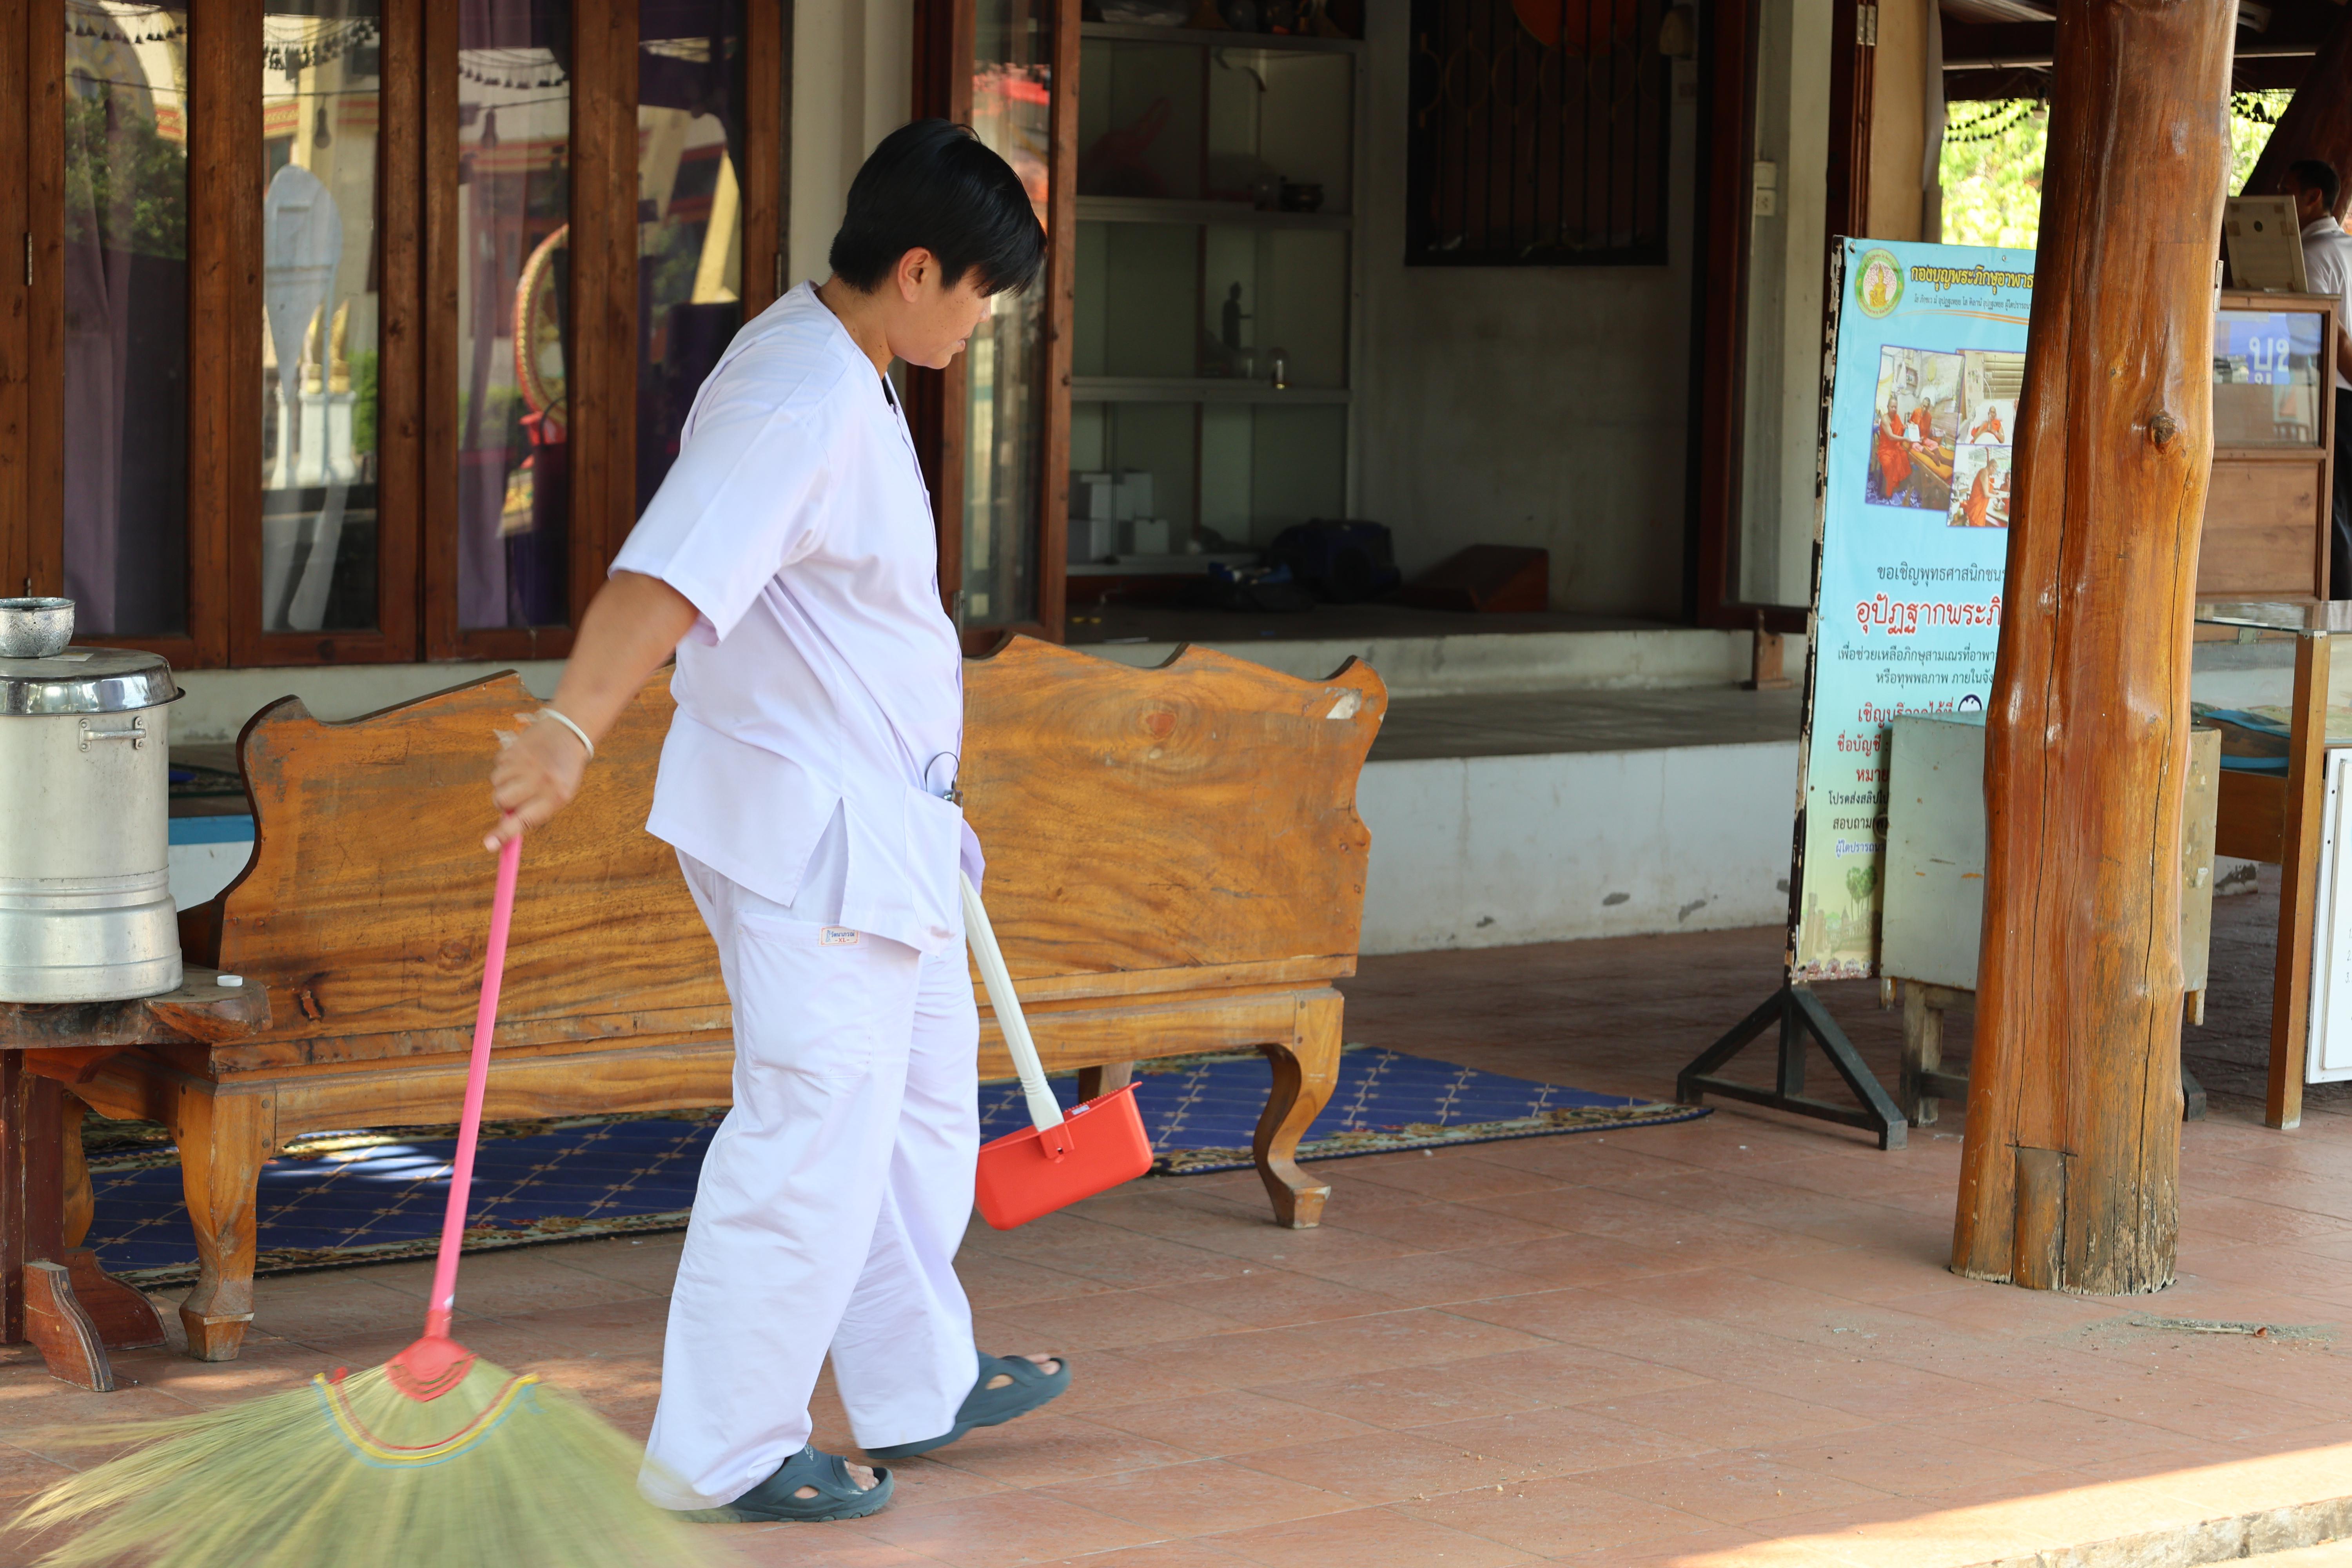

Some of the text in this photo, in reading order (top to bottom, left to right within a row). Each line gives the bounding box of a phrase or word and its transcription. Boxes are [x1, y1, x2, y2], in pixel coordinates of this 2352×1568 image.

[1838, 641, 1997, 666] เพื่อช่วยเหลือภิกษุสามเณรที่อาพา
[1876, 668, 1948, 689] หรือทุพพลภาพ
[1837, 730, 1882, 757] ชื่อบัญชี
